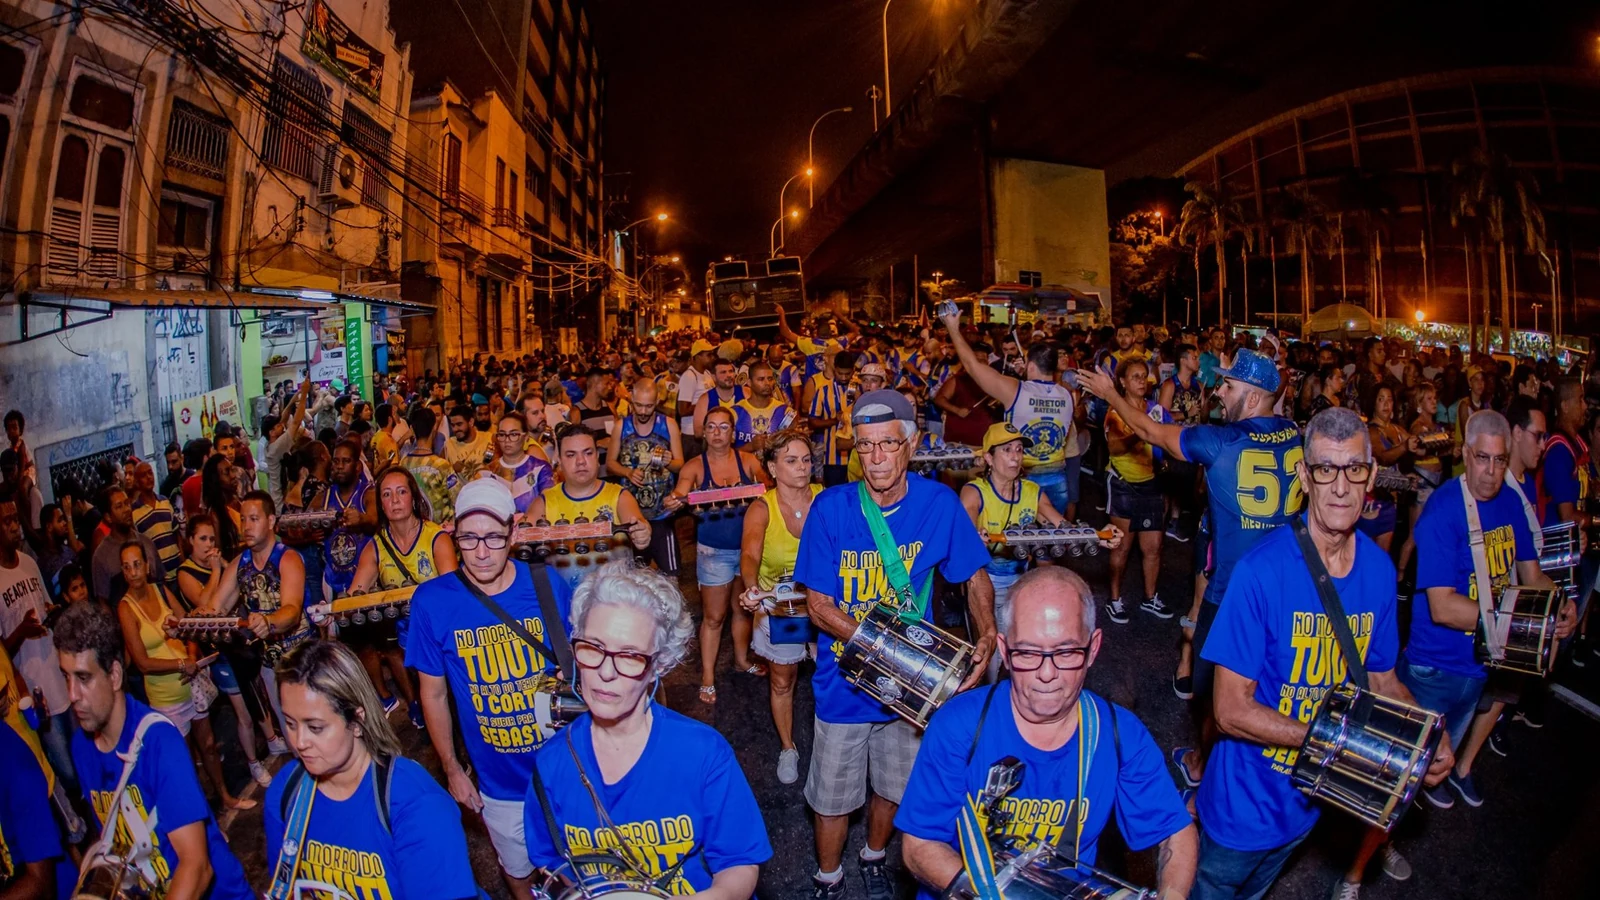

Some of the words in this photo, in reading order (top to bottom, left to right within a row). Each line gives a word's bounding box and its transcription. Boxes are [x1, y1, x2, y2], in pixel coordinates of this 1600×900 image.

[1029, 398, 1066, 407] DIRETOR
[738, 432, 756, 442] BA
[1236, 446, 1304, 517] 52
[840, 550, 857, 569] NO
[2, 580, 28, 608] BEACH
[26, 578, 41, 592] LIFE
[454, 629, 475, 648] NO
[476, 620, 522, 646] MORR
[524, 617, 544, 636] DO
[1292, 612, 1314, 637] NO
[1316, 613, 1359, 638] MOO
[472, 693, 484, 713] O
[488, 687, 536, 714] CORT
[1280, 684, 1296, 698] NO
[490, 716, 516, 727] SUBIR
[516, 712, 535, 725] PRA
[480, 723, 543, 747] SEBAST
[1002, 797, 1066, 826] MORRO
[565, 824, 593, 849] NO
[660, 814, 694, 844] DO
[307, 839, 359, 876] MORRO
[359, 851, 385, 878] DO
